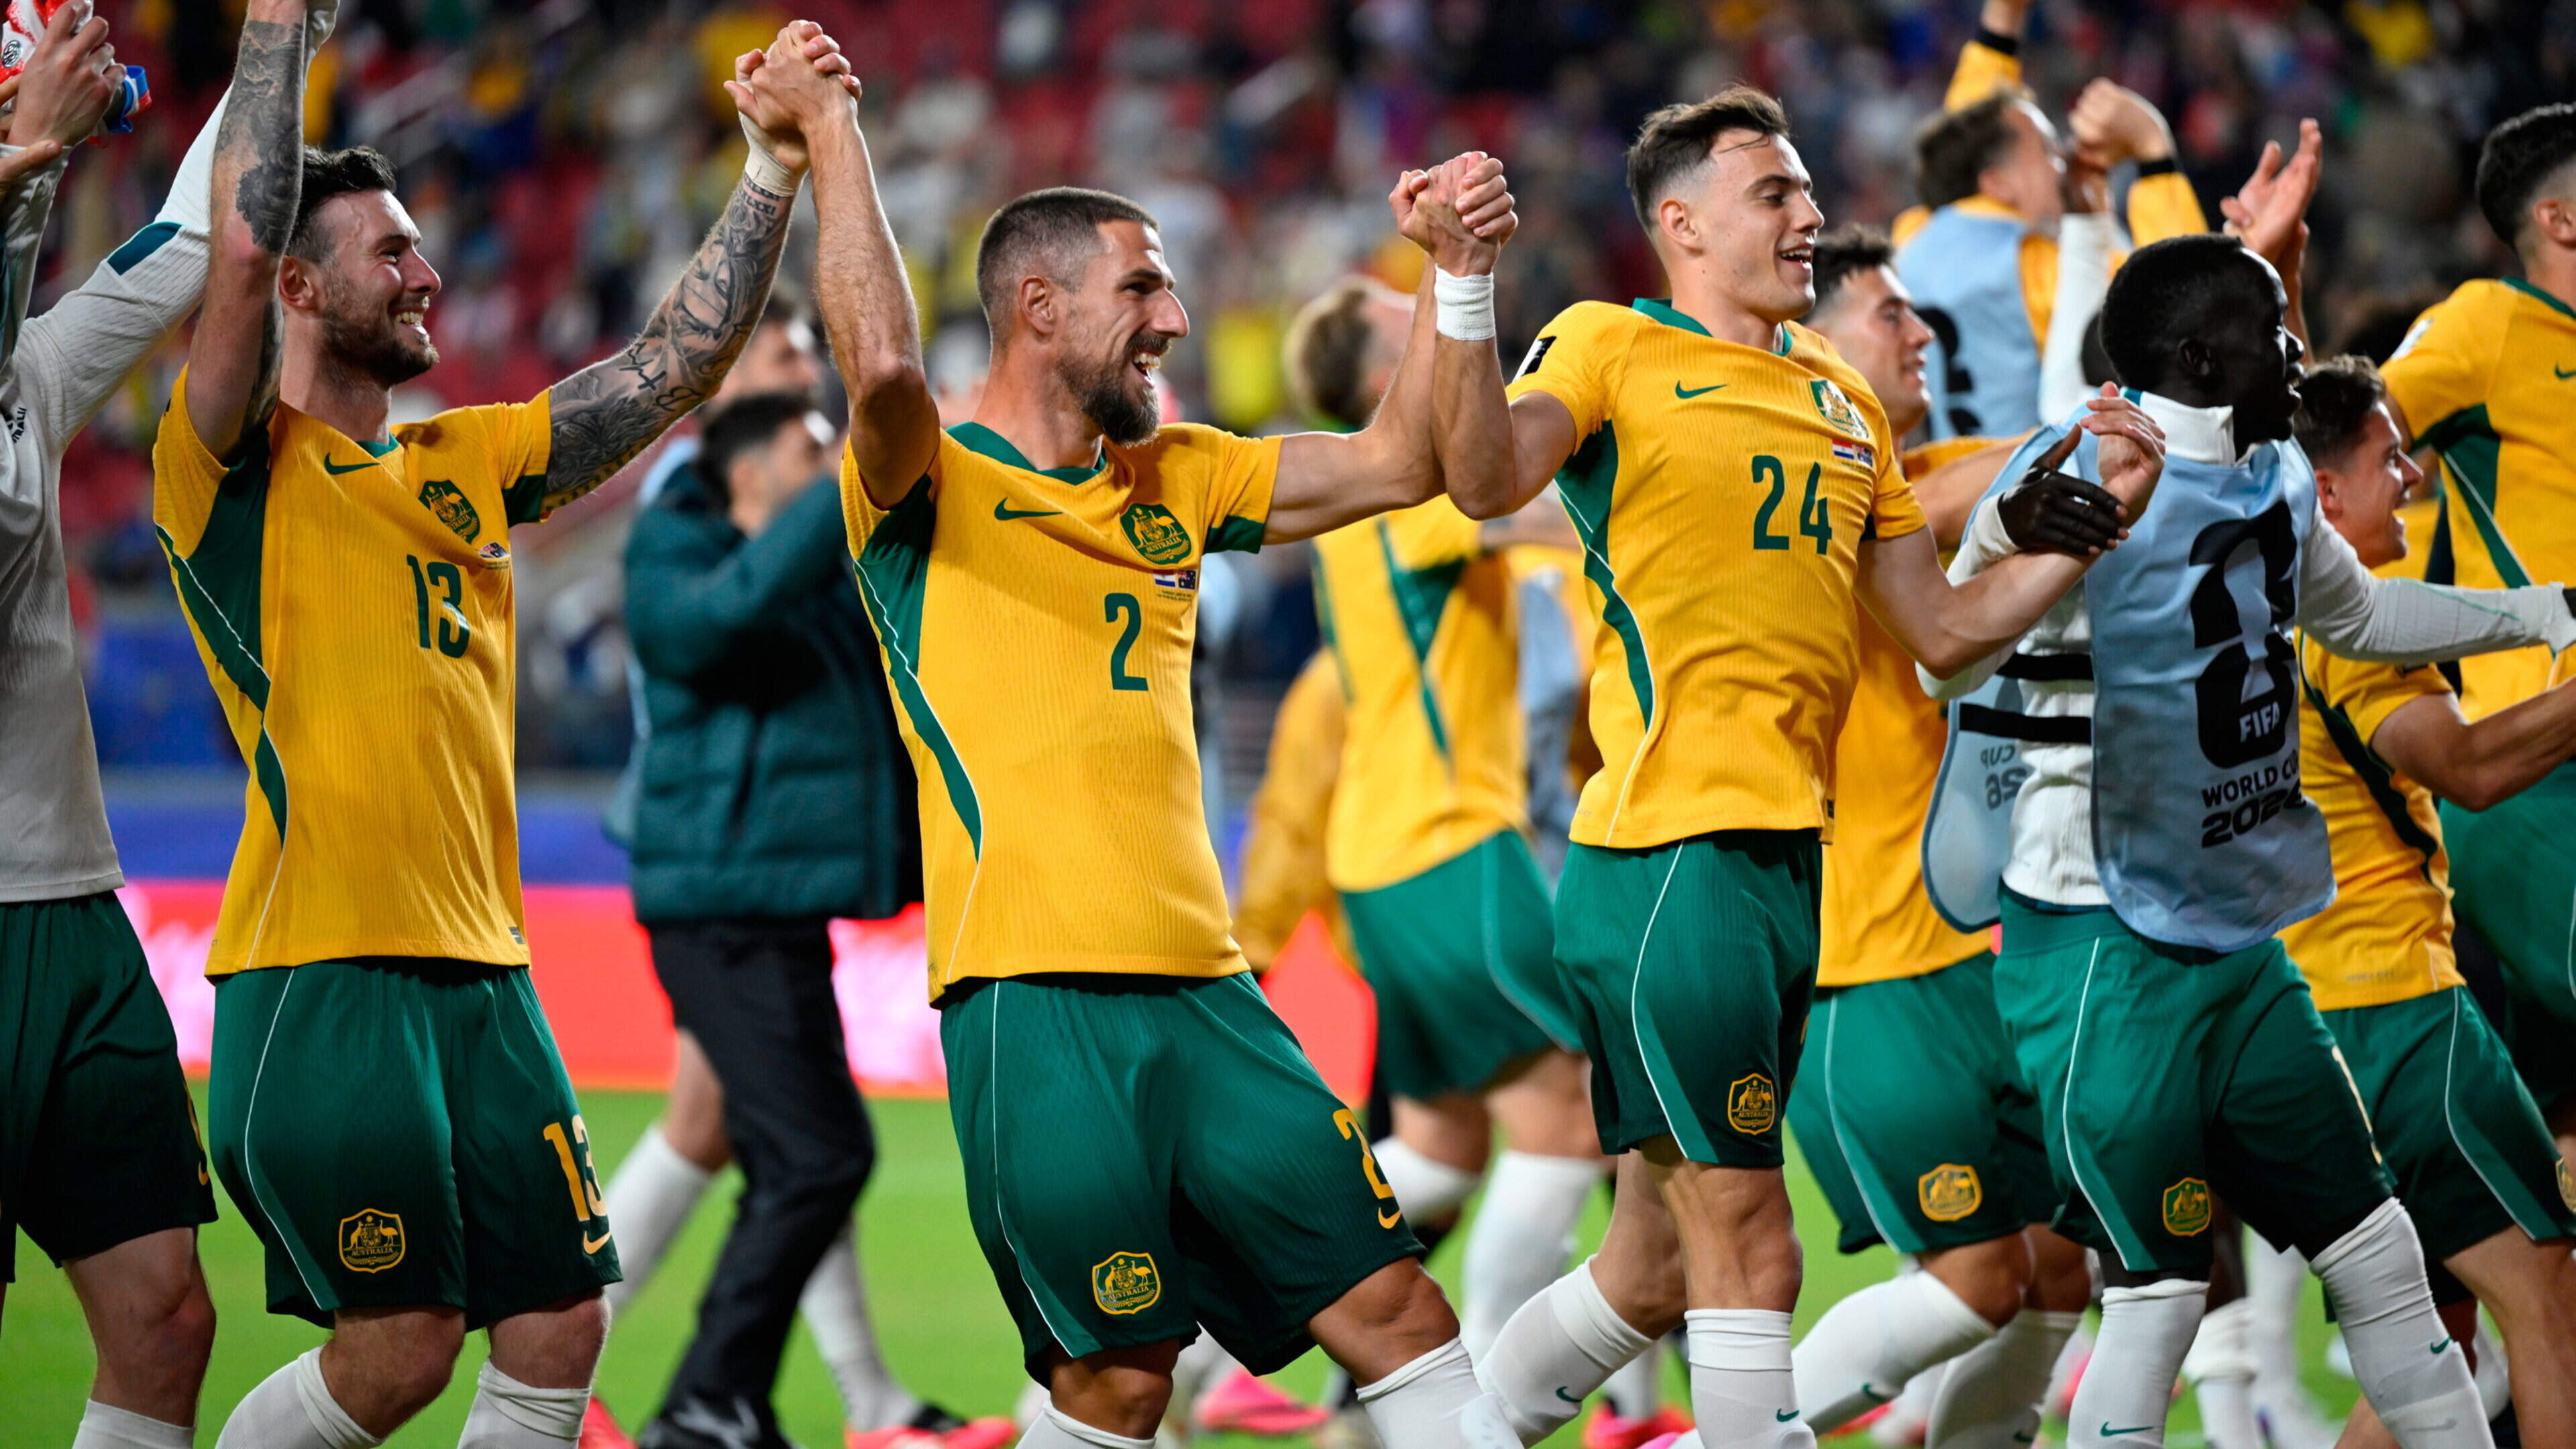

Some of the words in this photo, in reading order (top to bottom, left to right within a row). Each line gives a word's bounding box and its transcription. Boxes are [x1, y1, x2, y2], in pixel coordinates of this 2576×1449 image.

[1752, 455, 1832, 555] 24
[407, 554, 470, 659] 13
[1104, 592, 1148, 691] 2
[2239, 701, 2279, 743] FIFA
[2202, 766, 2279, 808] WORLD
[543, 1114, 607, 1222] 13
[1333, 1108, 1395, 1199] 2
[352, 1247, 394, 1256] AUSTRALIA
[1109, 1286, 1150, 1300] AUSTRALIA
